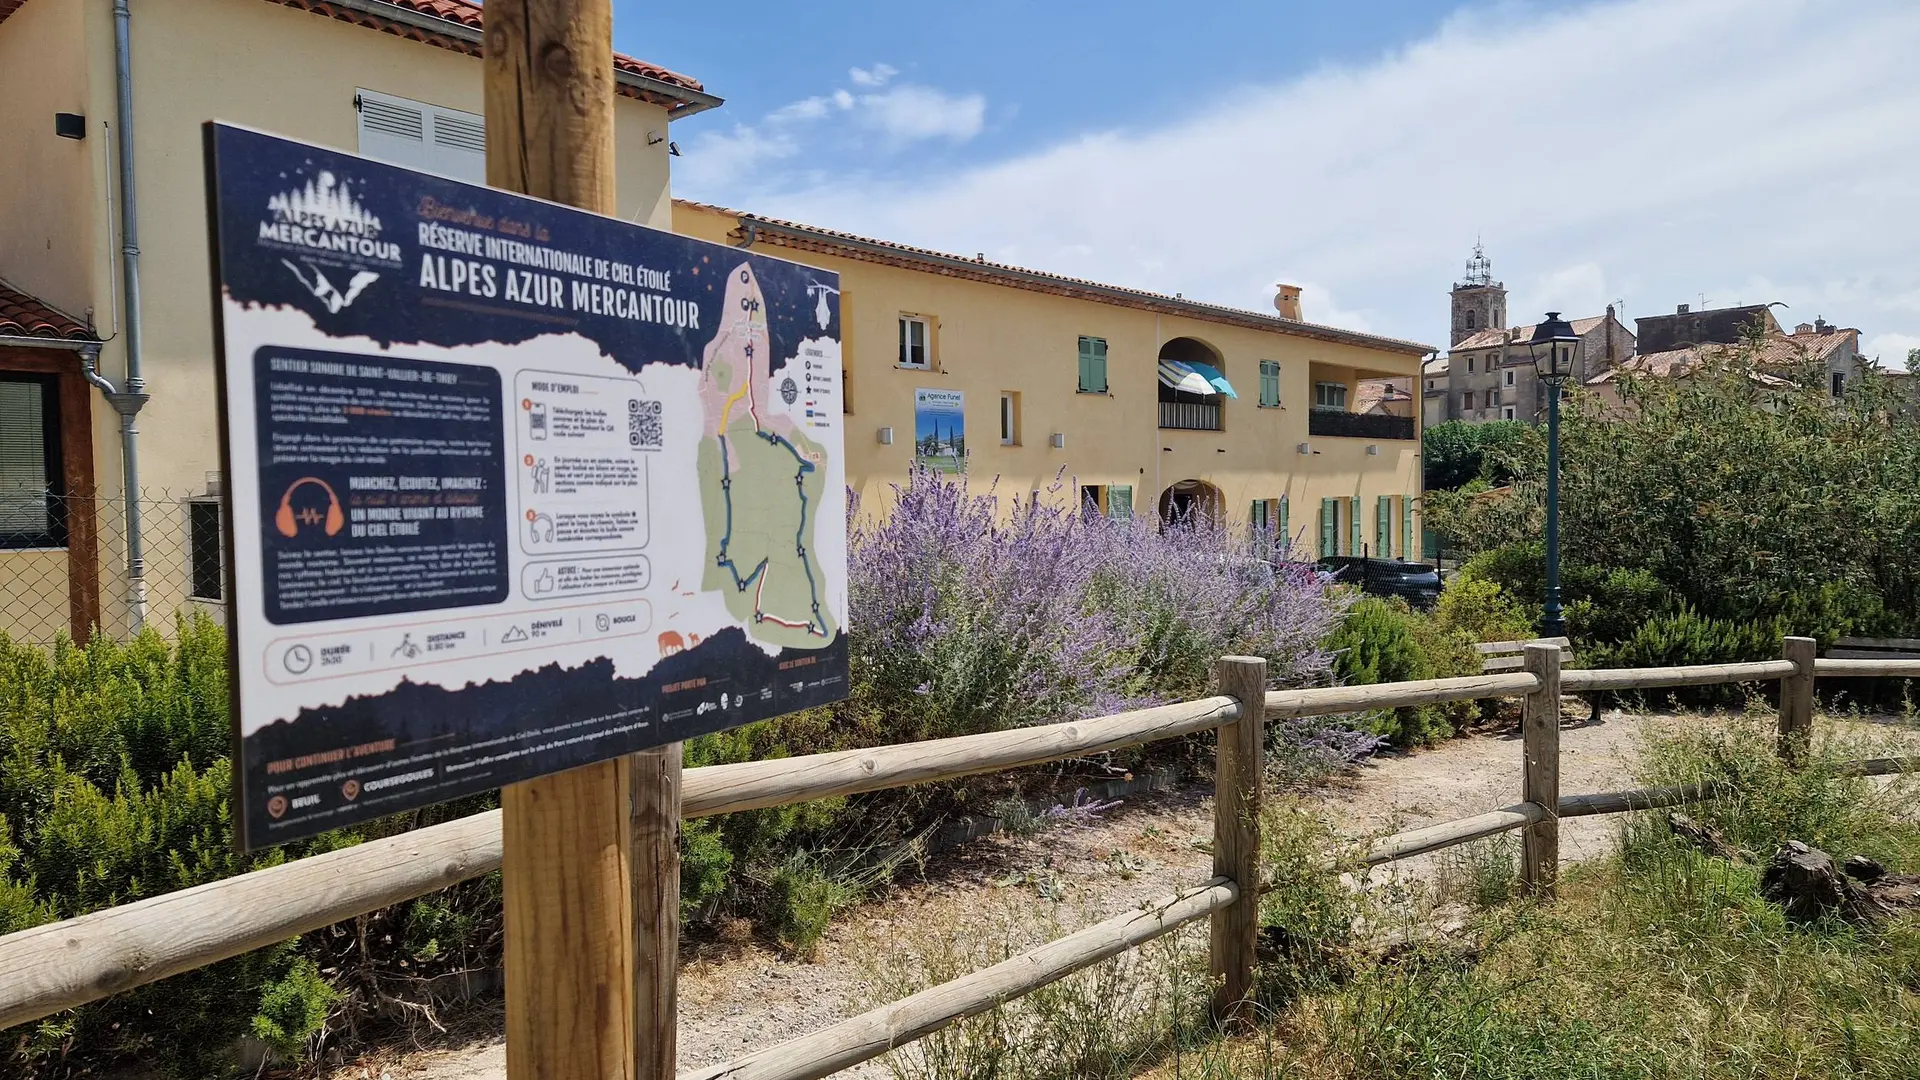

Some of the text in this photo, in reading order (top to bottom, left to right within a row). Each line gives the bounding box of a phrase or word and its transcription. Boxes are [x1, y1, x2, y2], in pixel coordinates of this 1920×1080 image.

[258, 219, 401, 261] MERCANTOUR
[418, 217, 483, 257] RÉSERVE
[485, 235, 592, 277] INTERNATIONALE
[594, 258, 610, 280] DE
[611, 261, 635, 285] CIEL
[636, 264, 671, 292] ÉTOILÉ
[418, 252, 497, 299] ALPES
[504, 267, 563, 309] AZUR
[572, 279, 699, 329] MERCANTOUR
[531, 381, 578, 394] MODE D'EMPLOI
[531, 617, 562, 630] DÉNIVELÉ
[613, 614, 635, 624] BOUCLE
[267, 737, 396, 775] POUR CONTINUER L'AVENTURE
[291, 792, 321, 809] BEUIL
[363, 767, 434, 792] COURSEGOULES
